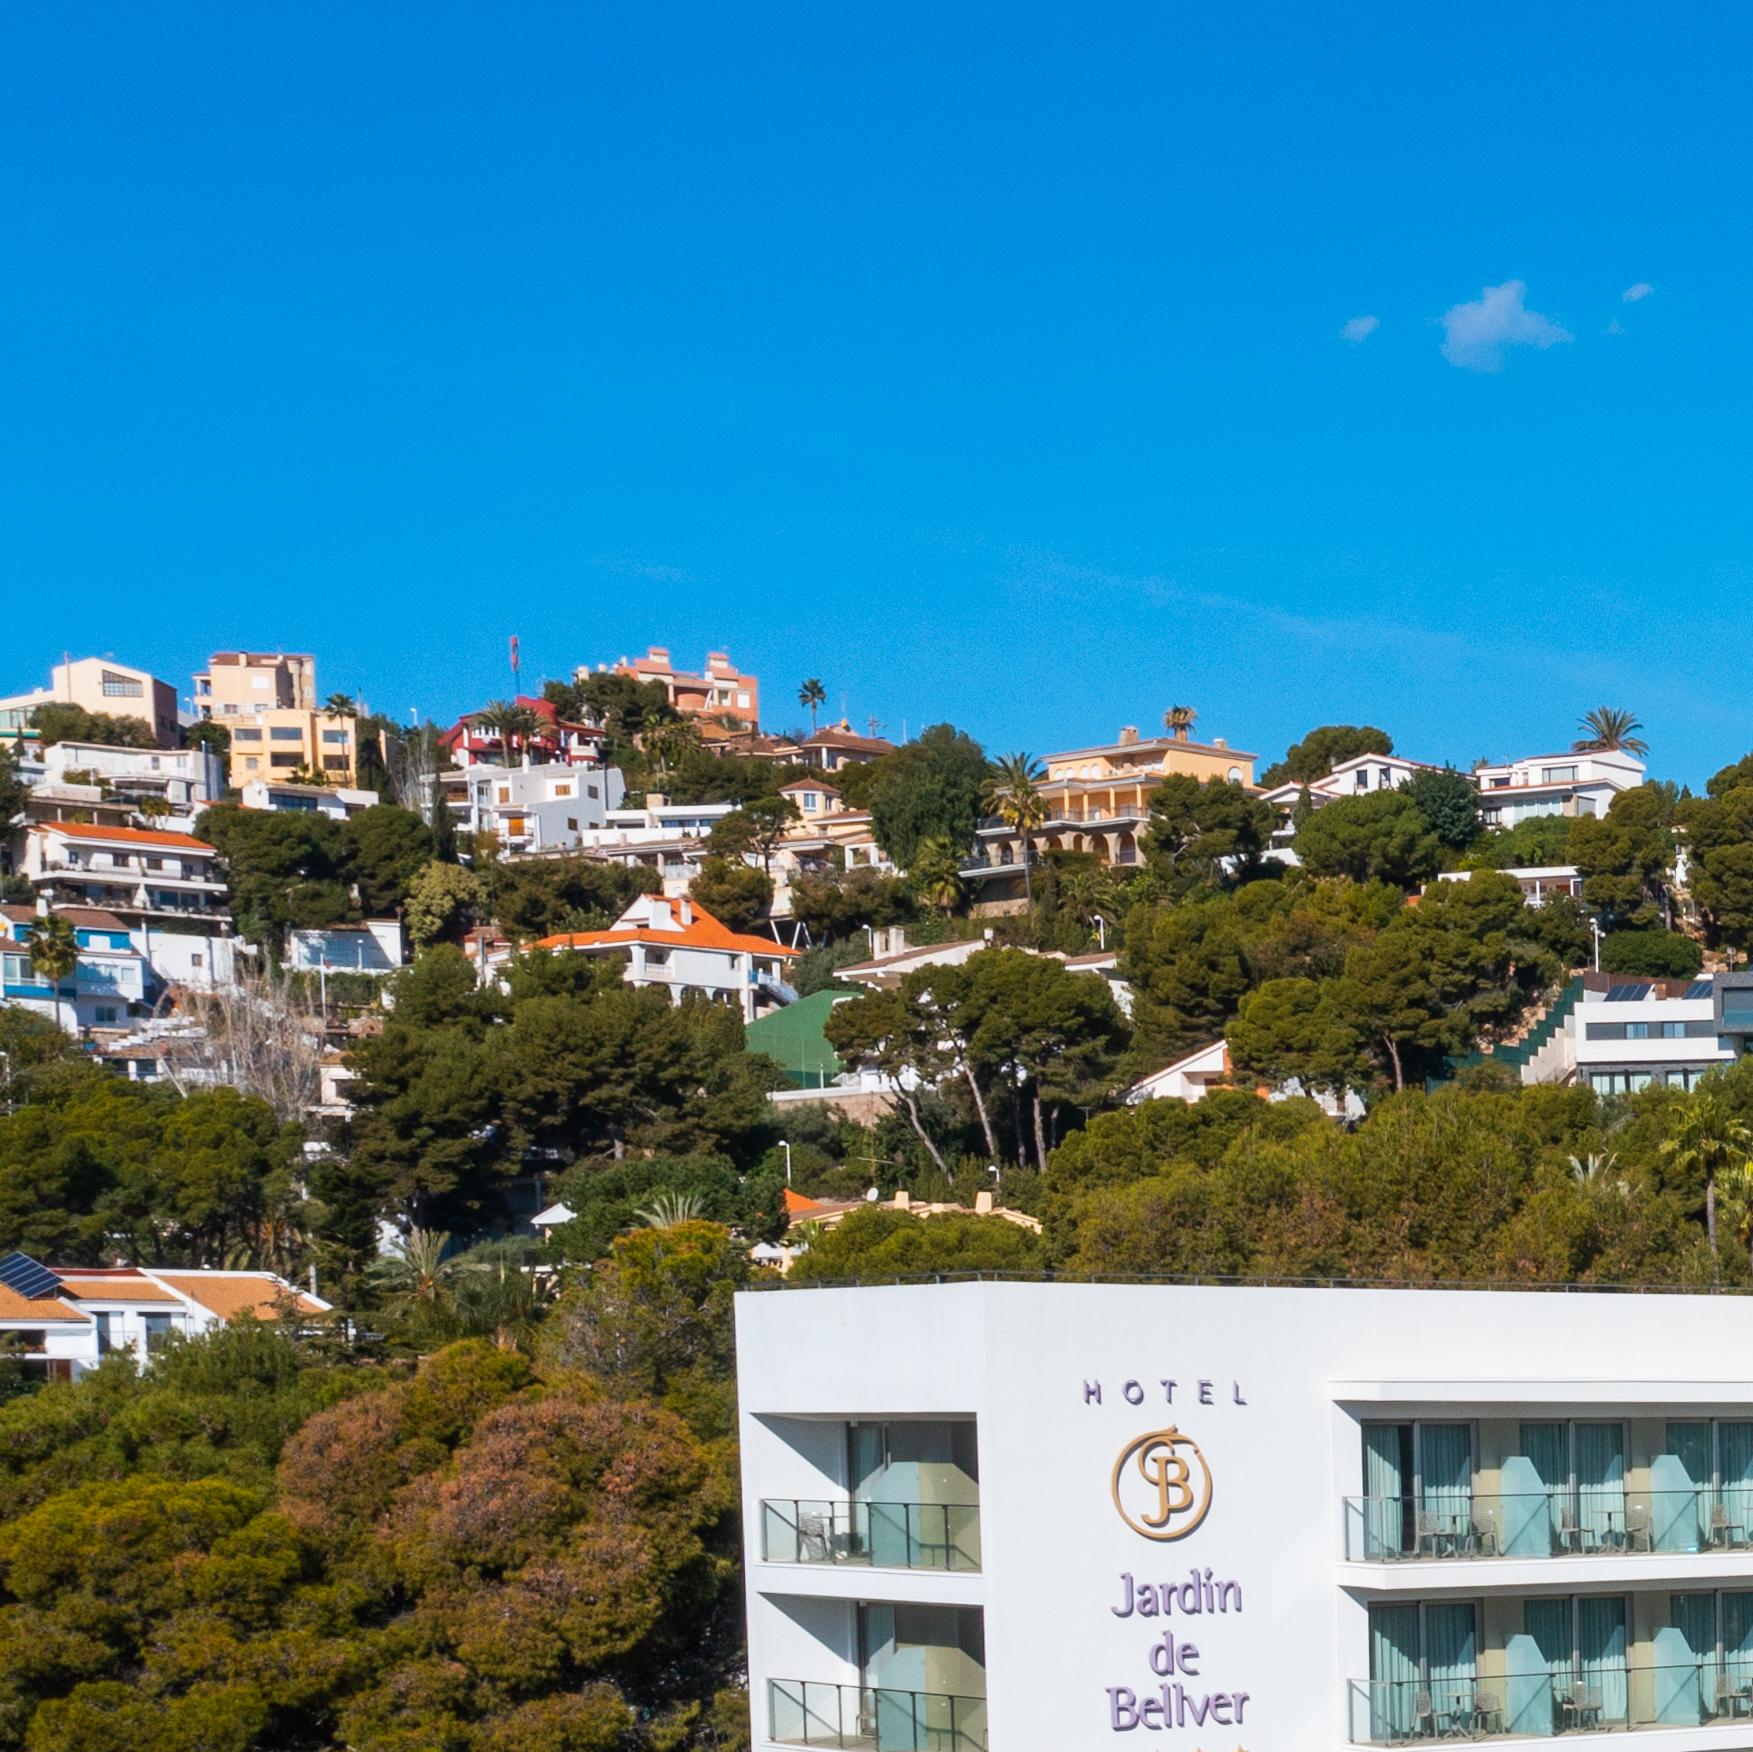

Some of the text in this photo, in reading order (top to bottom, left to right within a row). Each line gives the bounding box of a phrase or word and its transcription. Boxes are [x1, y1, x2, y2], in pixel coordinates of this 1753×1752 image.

[1082, 1379, 1248, 1405] HOTEL
[1148, 1630, 1200, 1676] de
[1105, 1681, 1250, 1732] Bellver
